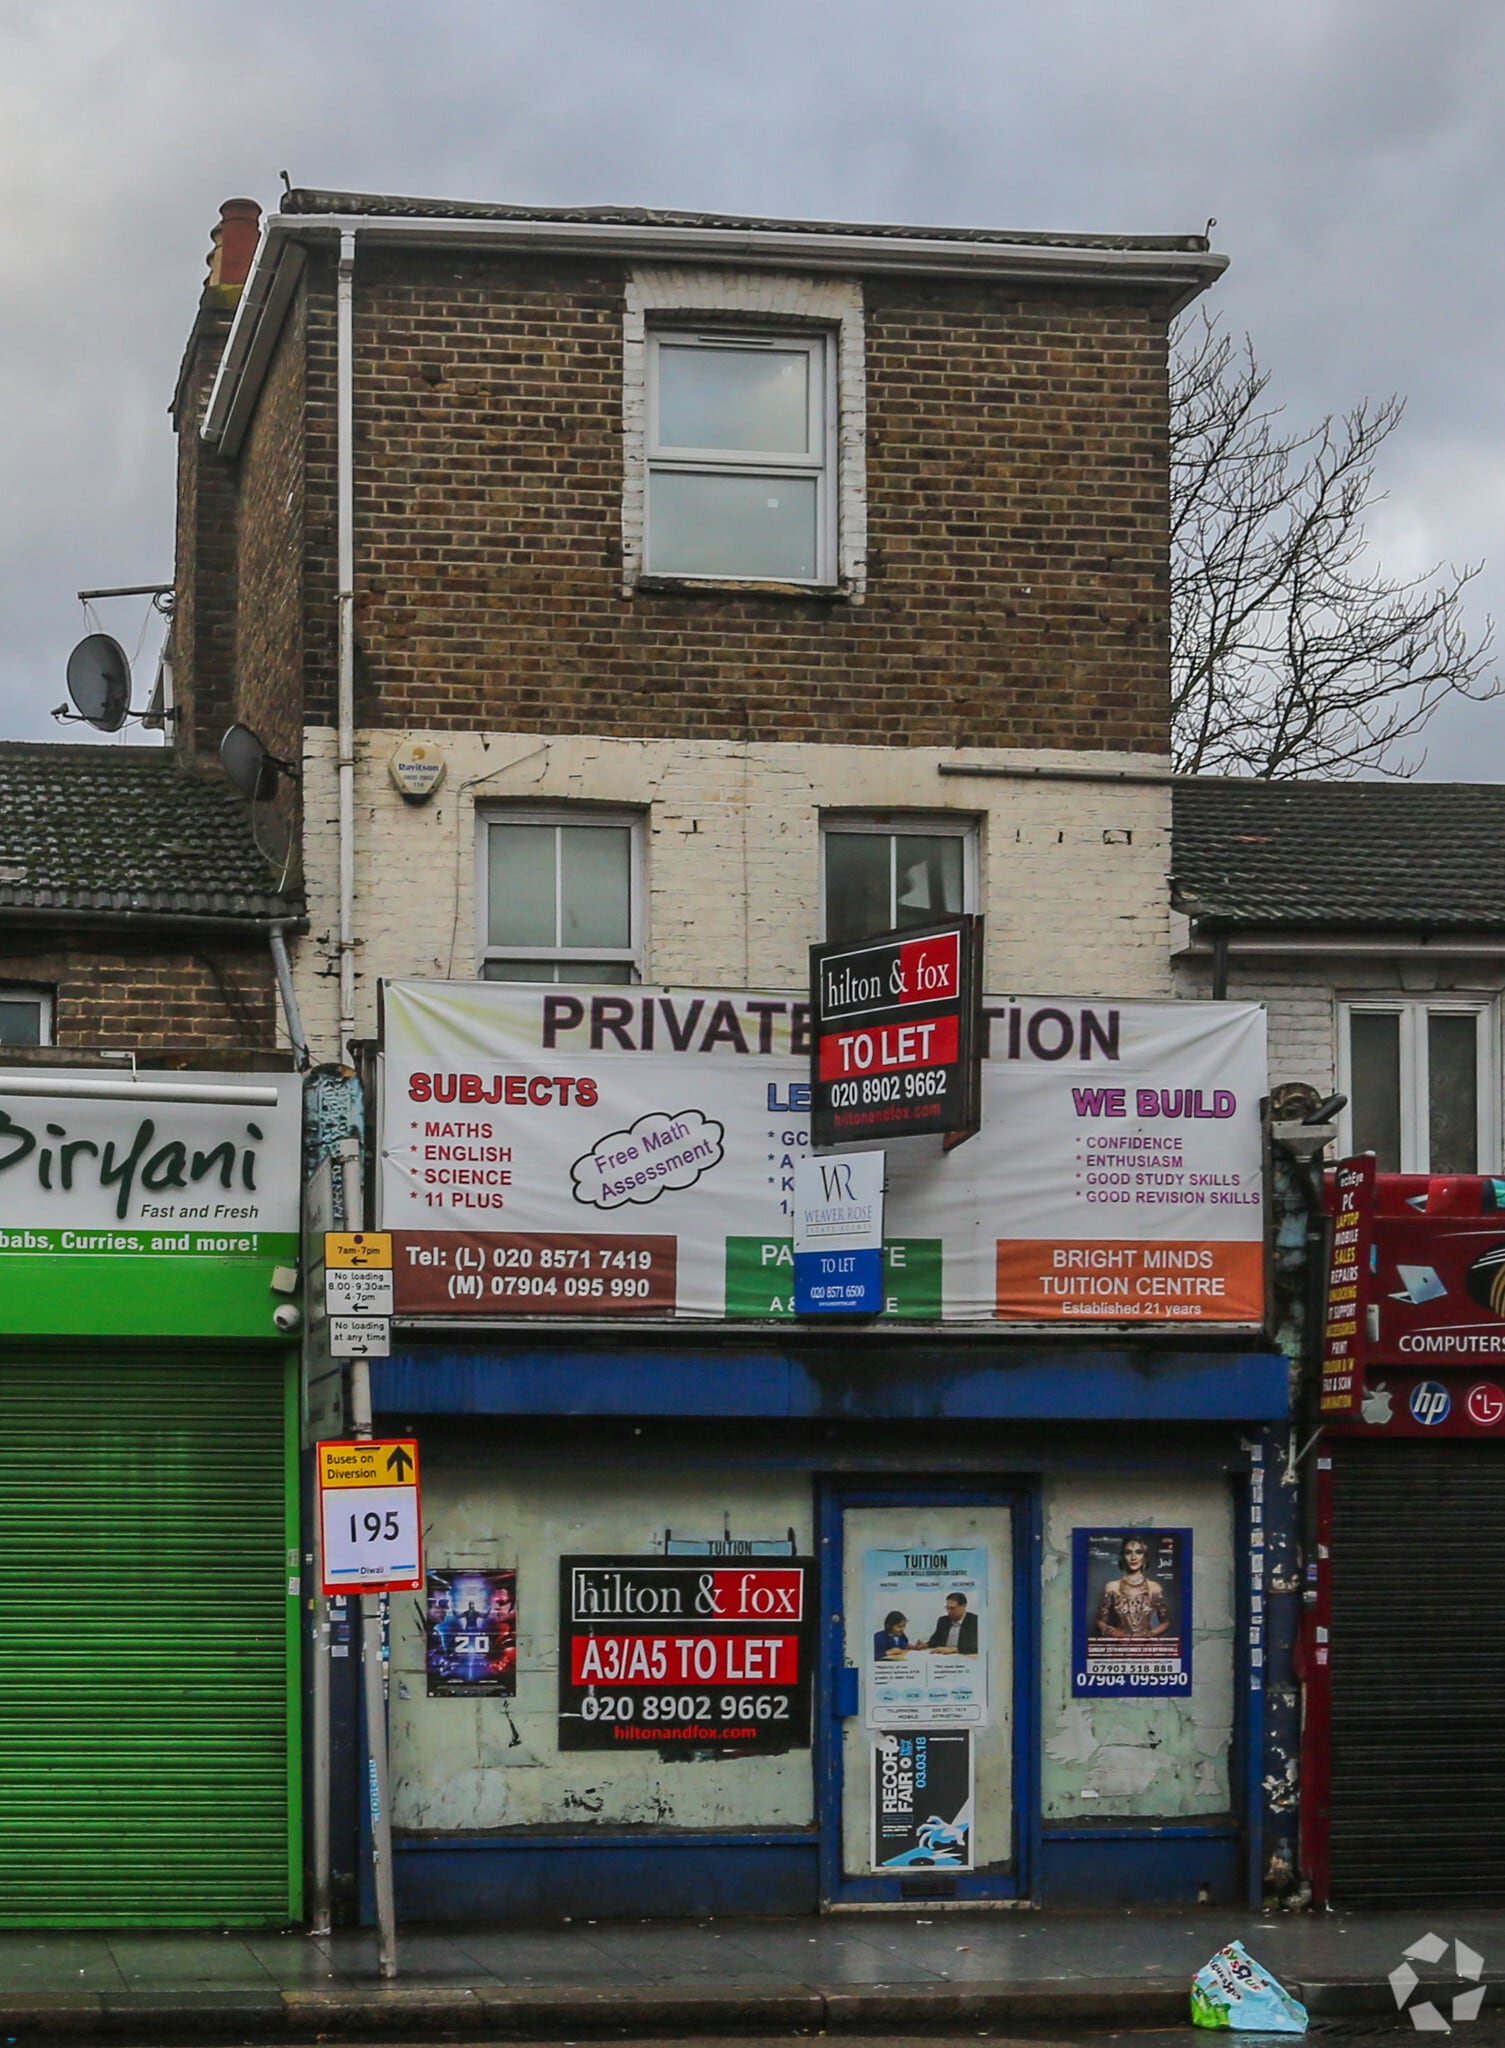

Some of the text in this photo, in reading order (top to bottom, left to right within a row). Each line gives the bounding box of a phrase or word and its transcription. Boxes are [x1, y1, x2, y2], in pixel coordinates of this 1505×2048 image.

[827, 952, 950, 1008] hilton & fox
[541, 994, 1121, 1062] PRIVATE TION
[838, 1023, 936, 1072] TO LET
[408, 1072, 600, 1107] SUBJECTS
[831, 1081, 858, 1109] 020
[862, 1075, 901, 1105] 8902
[904, 1070, 947, 1101] 9662
[1072, 1088, 1237, 1119] WE BUILD
[833, 1102, 941, 1127] hiltonandfox.com
[424, 1122, 493, 1139] MATHS
[594, 1120, 691, 1175] Free Math
[1086, 1136, 1184, 1150] CONFIDENCE
[424, 1145, 512, 1163] ENGLISH
[1086, 1154, 1184, 1169] ENTHUSIASM
[424, 1168, 513, 1187] SCIENCE
[600, 1138, 715, 1202] Assessment
[1086, 1172, 1241, 1187] GOOD STUDY SKILLS
[424, 1192, 504, 1210] 11 PLUS
[1086, 1191, 1260, 1206] GOOD REVISION SKILLS
[1342, 1191, 1355, 1212] PC
[140, 1203, 260, 1220] Fast and Fresh
[804, 1205, 873, 1223] WEAVER ROSE
[1335, 1211, 1360, 1229] LAPTOP
[61, 1232, 145, 1252] Curries,
[151, 1234, 191, 1252] and
[196, 1235, 259, 1253] more!
[1334, 1228, 1359, 1247] MOBILE
[405, 1246, 653, 1271] Tel: (L) 020 8571 7419
[820, 1257, 857, 1274] TO LET
[1053, 1248, 1214, 1270] BRIGHT MINDS
[1334, 1246, 1356, 1266] SALES
[335, 1272, 384, 1282] No loading
[1330, 1265, 1359, 1285] REPAIRS
[447, 1276, 651, 1300] (M) 07904 095 990
[810, 1284, 866, 1299] 020 8571 6500
[1040, 1275, 1226, 1297] TUITION CENTRE
[769, 1296, 784, 1313] A
[1062, 1301, 1202, 1317] Established 21 years
[335, 1321, 385, 1332] No loading
[334, 1333, 386, 1343] at any time
[1413, 1381, 1448, 1425] hp
[326, 1454, 375, 1465] Buses on
[327, 1468, 377, 1480] Diversion
[350, 1511, 400, 1543] 195
[707, 1541, 753, 1555] TUITION
[360, 1565, 384, 1575] Diwali
[903, 1554, 948, 1569] TUITION
[576, 1573, 797, 1614] hilton & fox
[580, 1638, 784, 1680] A3/A5 TO LET
[1092, 1664, 1174, 1673] 07903 518 888
[1076, 1673, 1188, 1686] 07904 095990
[581, 1695, 790, 1722] 020 8902 9662
[613, 1724, 757, 1740] hiltonandfox.com
[915, 1736, 928, 1789] 03.03.18
[898, 1771, 914, 1814] FAIR
